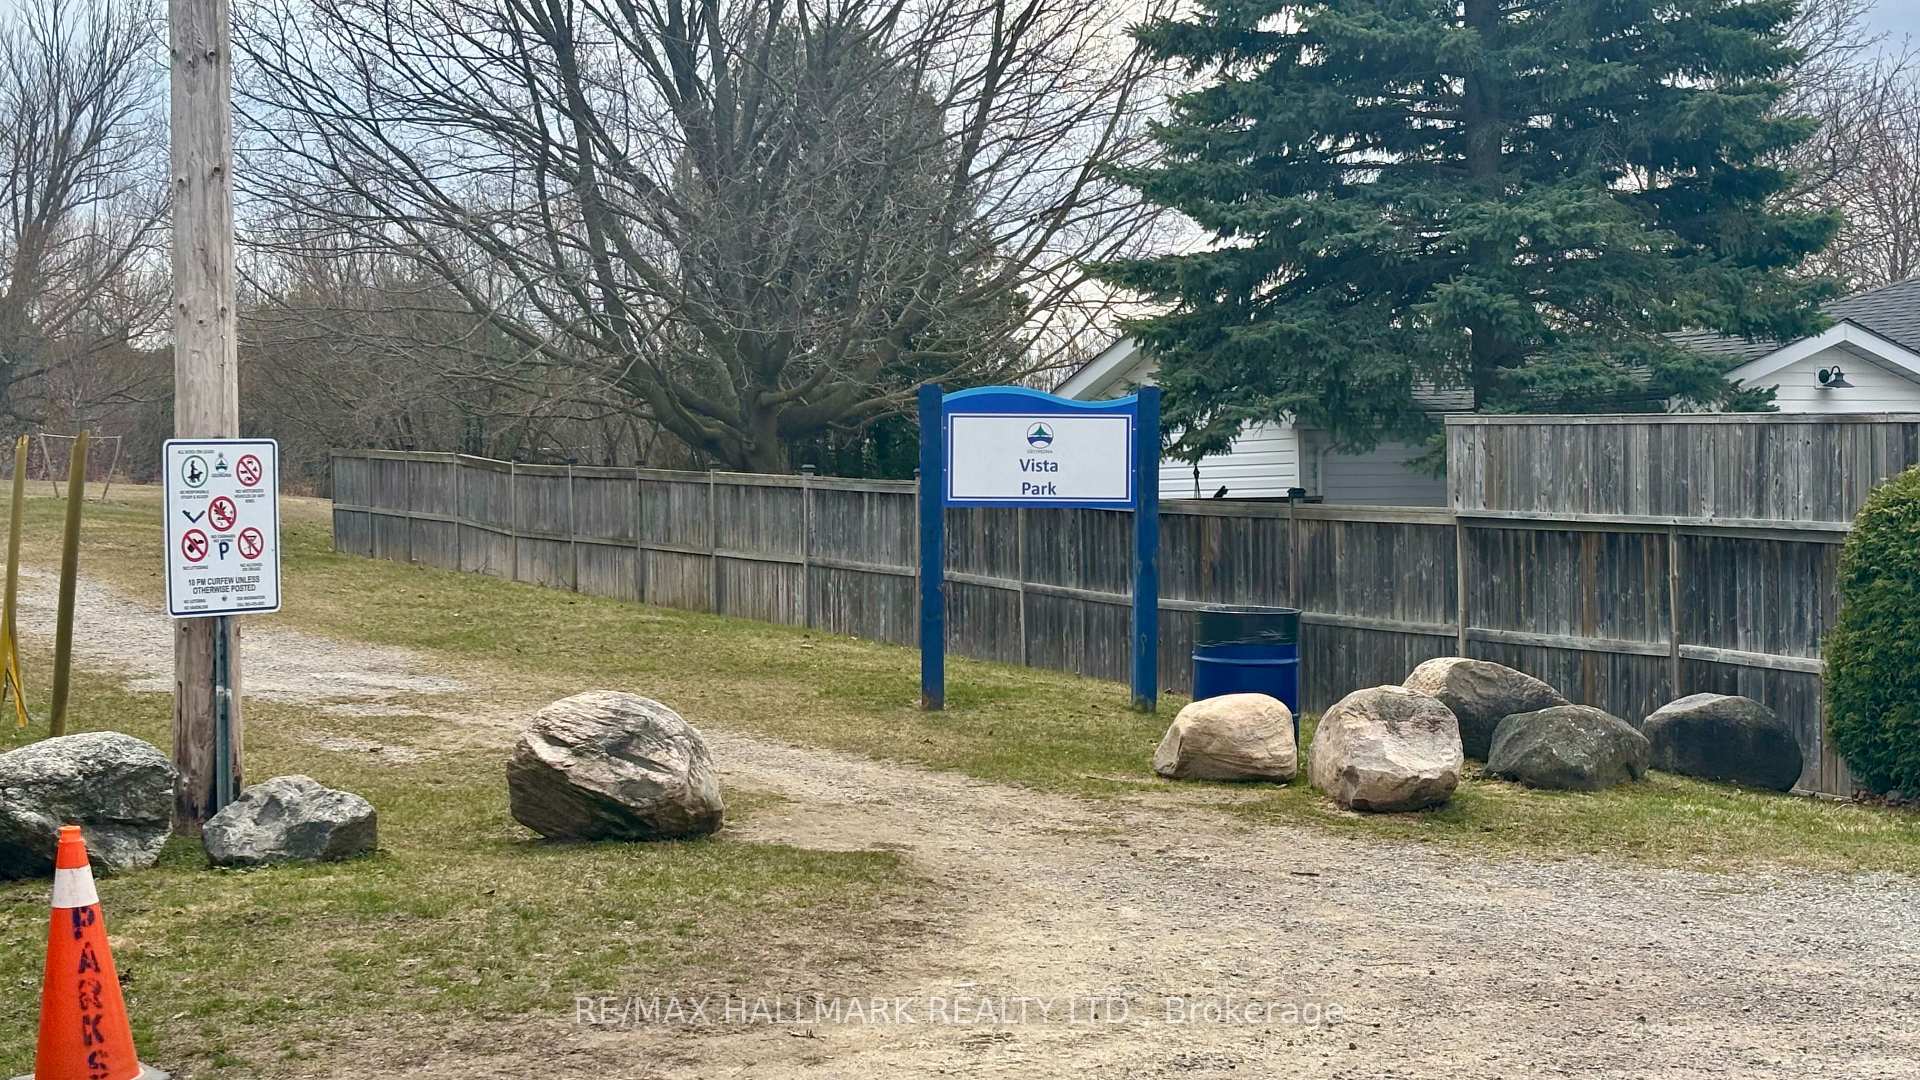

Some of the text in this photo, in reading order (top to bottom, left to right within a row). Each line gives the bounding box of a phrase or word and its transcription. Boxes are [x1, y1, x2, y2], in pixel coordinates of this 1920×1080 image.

[1019, 458, 1059, 473] Vista
[1022, 481, 1057, 496] Park
[196, 578, 206, 586] PM
[207, 576, 235, 586] CURFEW
[235, 575, 260, 584] UNLESS
[192, 584, 257, 595] OTHERWISE POSTED
[71, 905, 110, 1080] PARKS
